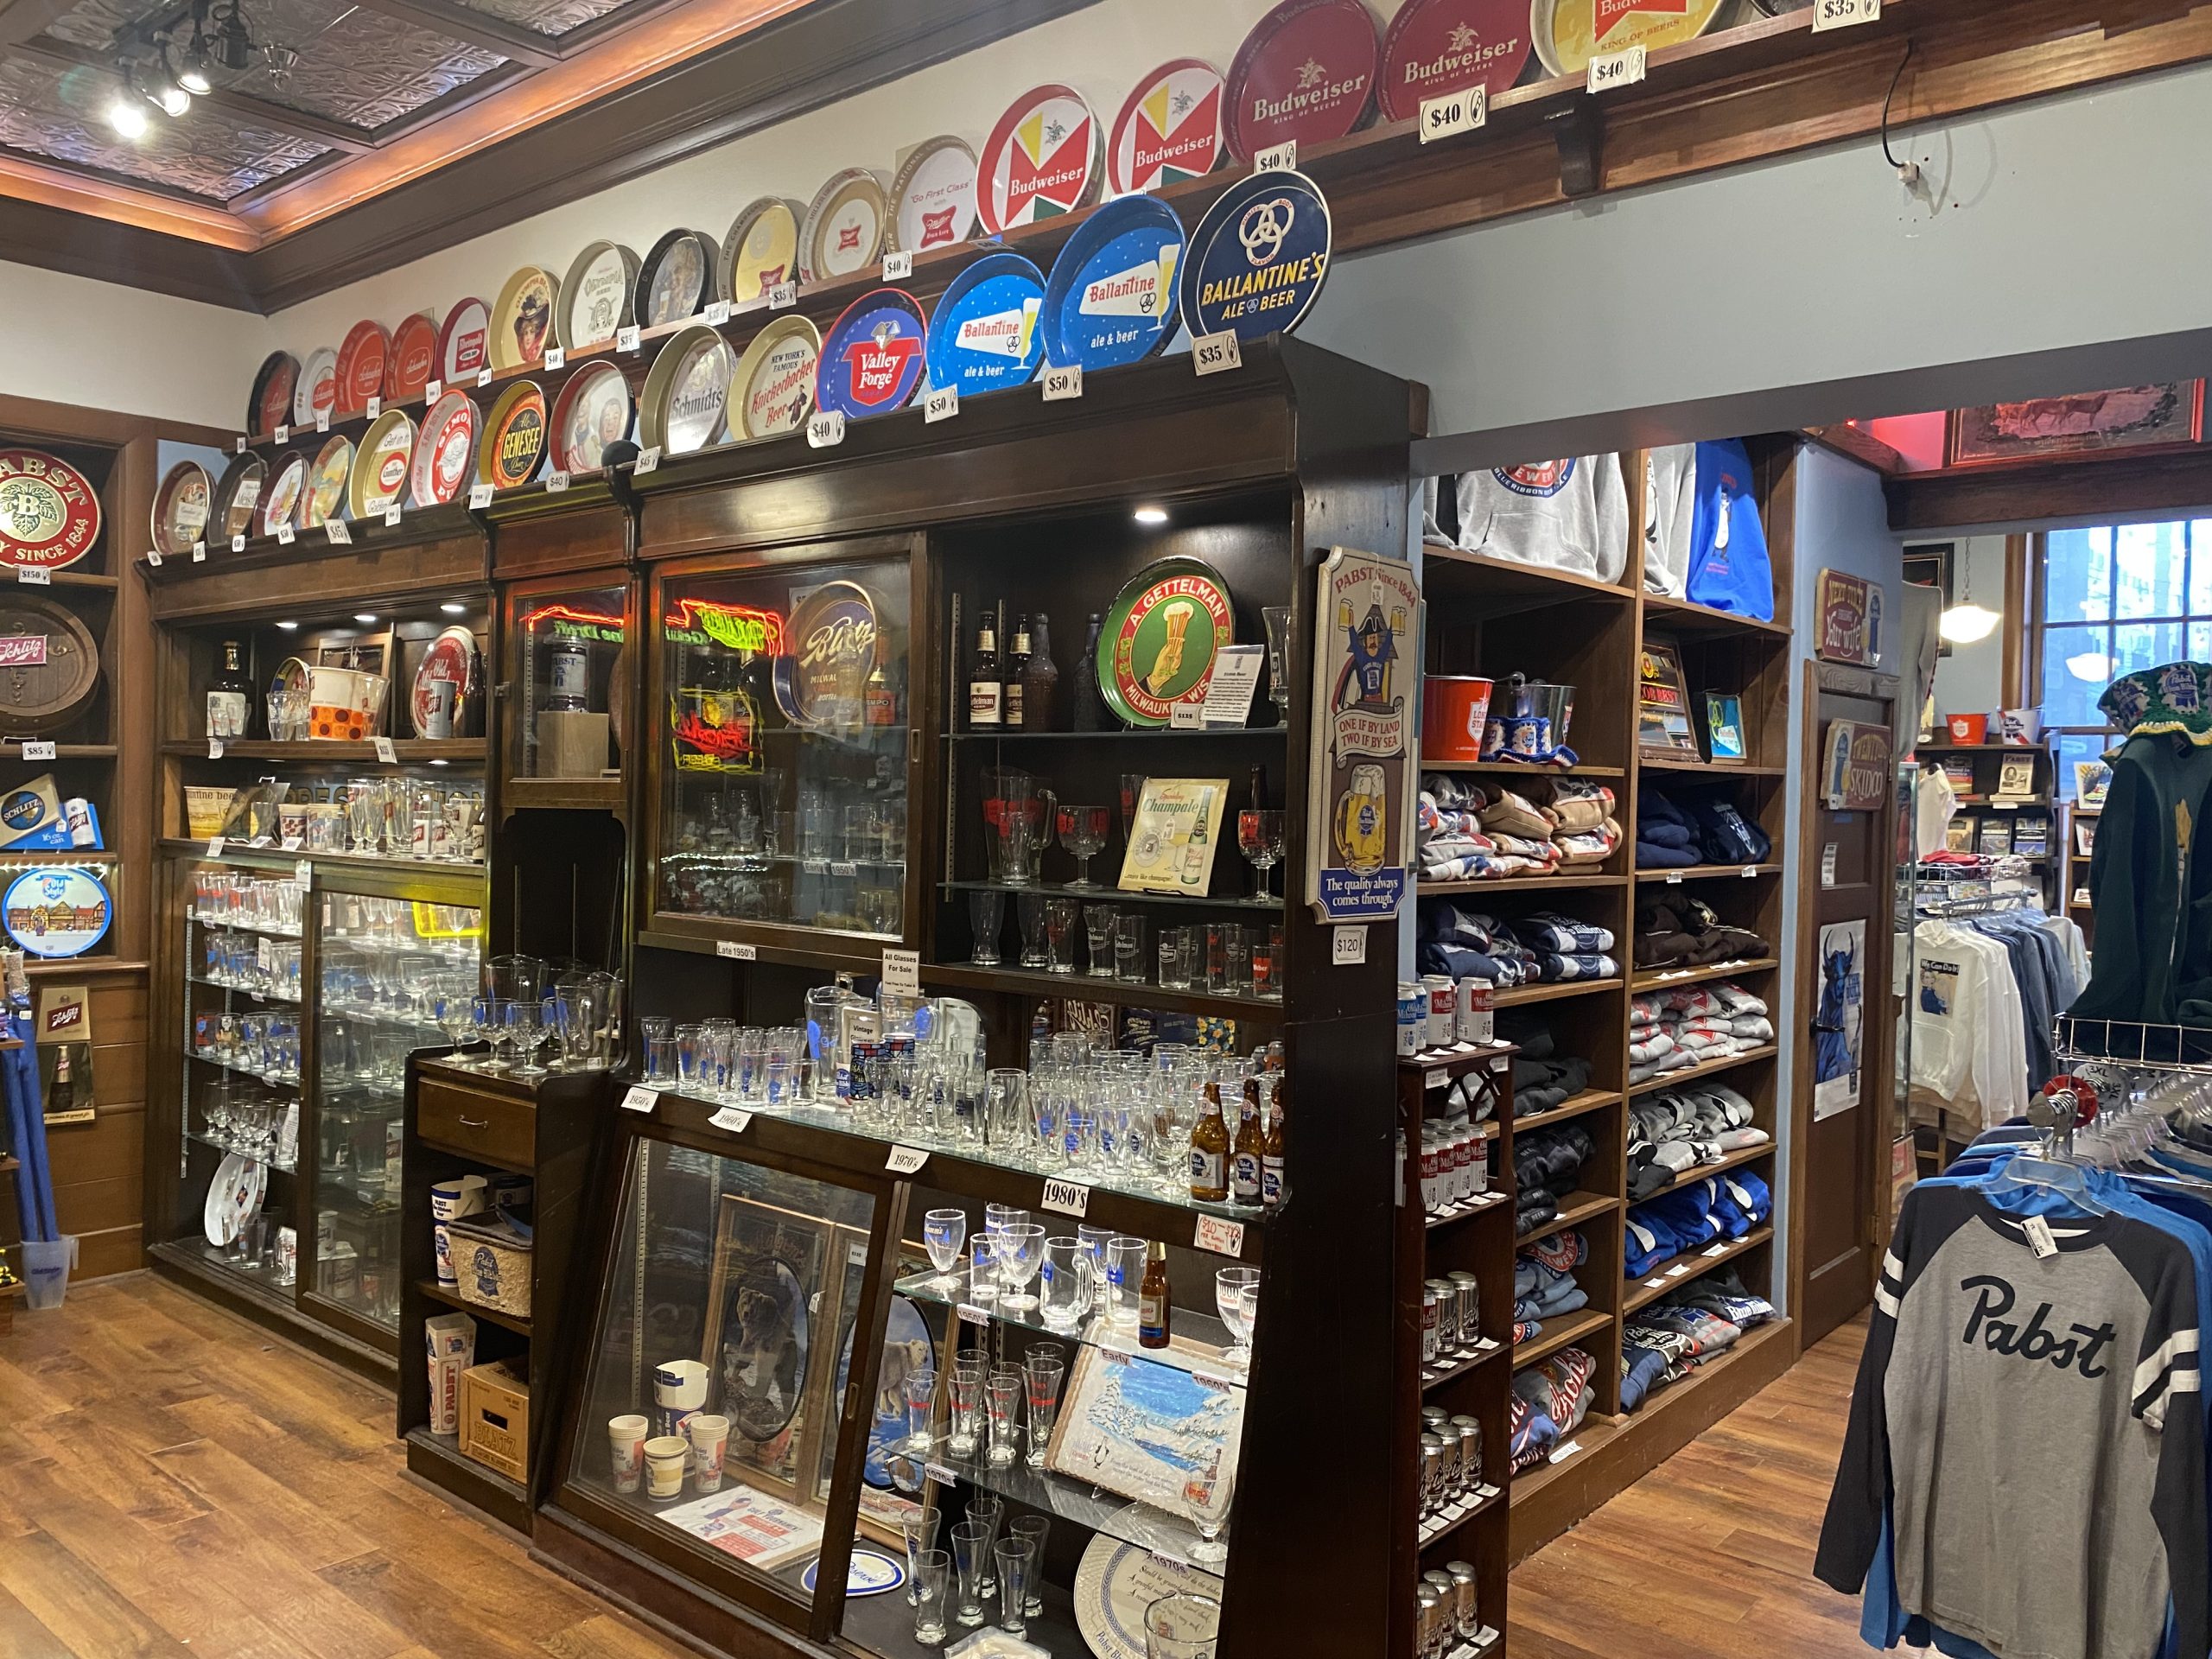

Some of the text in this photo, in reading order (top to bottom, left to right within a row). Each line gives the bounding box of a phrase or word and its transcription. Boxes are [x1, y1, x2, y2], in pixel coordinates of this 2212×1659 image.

[1823, 0, 1855, 19] $35
[1601, 18, 1681, 52] KING OF BEERS
[1404, 37, 1518, 84] Budweiser
[1425, 77, 1440, 86] KING
[1465, 62, 1492, 74] BEERS
[1597, 61, 1624, 80] $40
[1253, 74, 1365, 122] Budweiser
[1274, 114, 1294, 124] KING
[1313, 100, 1341, 112] BEERS
[1432, 104, 1460, 128] $40
[1135, 134, 1213, 168] Budweiser
[1260, 153, 1280, 170] $40
[895, 151, 925, 193] NATIONAL
[1009, 168, 1084, 197] Budweiser
[925, 188, 944, 202] First
[1279, 199, 1293, 208] BODY
[927, 213, 950, 229] Miller
[887, 261, 901, 273] $40
[1252, 253, 1274, 266] FLAVOR
[1201, 251, 1326, 307] BALLANTINE'S
[773, 290, 787, 302] $35
[1090, 275, 1155, 303] Ballantine
[1221, 289, 1295, 321] ALE BEER
[964, 320, 1020, 339] Ballantine
[1091, 328, 1139, 348] ale & beer
[771, 349, 806, 365] NEW YORK'S
[861, 351, 901, 375] Valley
[1200, 345, 1223, 365] $35
[773, 360, 798, 373] FAMOUS
[964, 365, 1005, 378] ale & beer
[751, 359, 816, 416] Knickerbocker
[858, 372, 893, 391] Forge
[1048, 375, 1068, 391] $50
[672, 387, 722, 418] Schmidt's
[930, 397, 946, 414] $50
[766, 404, 788, 428] Beer
[812, 421, 830, 438] $40
[503, 427, 540, 460] GENESEE
[639, 457, 651, 468] $45
[383, 465, 404, 478] Gunther
[550, 476, 563, 487] $40
[1494, 467, 1510, 486] BLUE
[1511, 485, 1544, 495] RIBBON
[17, 493, 41, 515] B
[15, 518, 89, 562] SINCE 1844
[22, 569, 41, 579] $150
[1335, 567, 1416, 608] PABST Since 1844
[1130, 579, 1225, 627] A. GETTELMAN
[1842, 619, 1861, 658] wife
[435, 657, 448, 677] Old
[1339, 718, 1400, 734] ONE IF BY LAND
[1342, 733, 1398, 747] TWO IF BY SEA
[27, 747, 43, 755] $85
[3, 798, 42, 822] SCHLITZ
[1142, 798, 1199, 817] Champale
[42, 834, 51, 842] 16
[805, 864, 855, 875] Early 1950's
[44, 886, 64, 899] Style
[51, 880, 64, 888] Old
[1326, 877, 1398, 894] The quality always
[1332, 892, 1394, 909] comes through.
[717, 945, 755, 958] Late 1950's
[1338, 938, 1357, 953] $120
[893, 954, 917, 963] Glasses
[1922, 958, 1930, 967] We
[1930, 961, 1942, 970] Can
[52, 1007, 79, 1027] Schlitz
[854, 1025, 874, 1034] Vintage
[2090, 1065, 2108, 1077] 3XL
[2109, 1082, 2121, 1099] 3XL
[628, 1094, 650, 1106] 1950's
[719, 1114, 742, 1127] 1960's
[893, 1154, 918, 1168] 1970's
[1044, 1182, 1087, 1209] 1980's
[1727, 1305, 1752, 1320] Blue
[1960, 1274, 2117, 1379] Pabst
[1102, 1350, 1128, 1365] Early
[446, 1366, 456, 1411] PABST
[1193, 1375, 1230, 1391] 1960's
[474, 1423, 518, 1459] BLATZ
[1154, 1556, 1187, 1574] 1970s
[1096, 1630, 1113, 1653] Pabst
